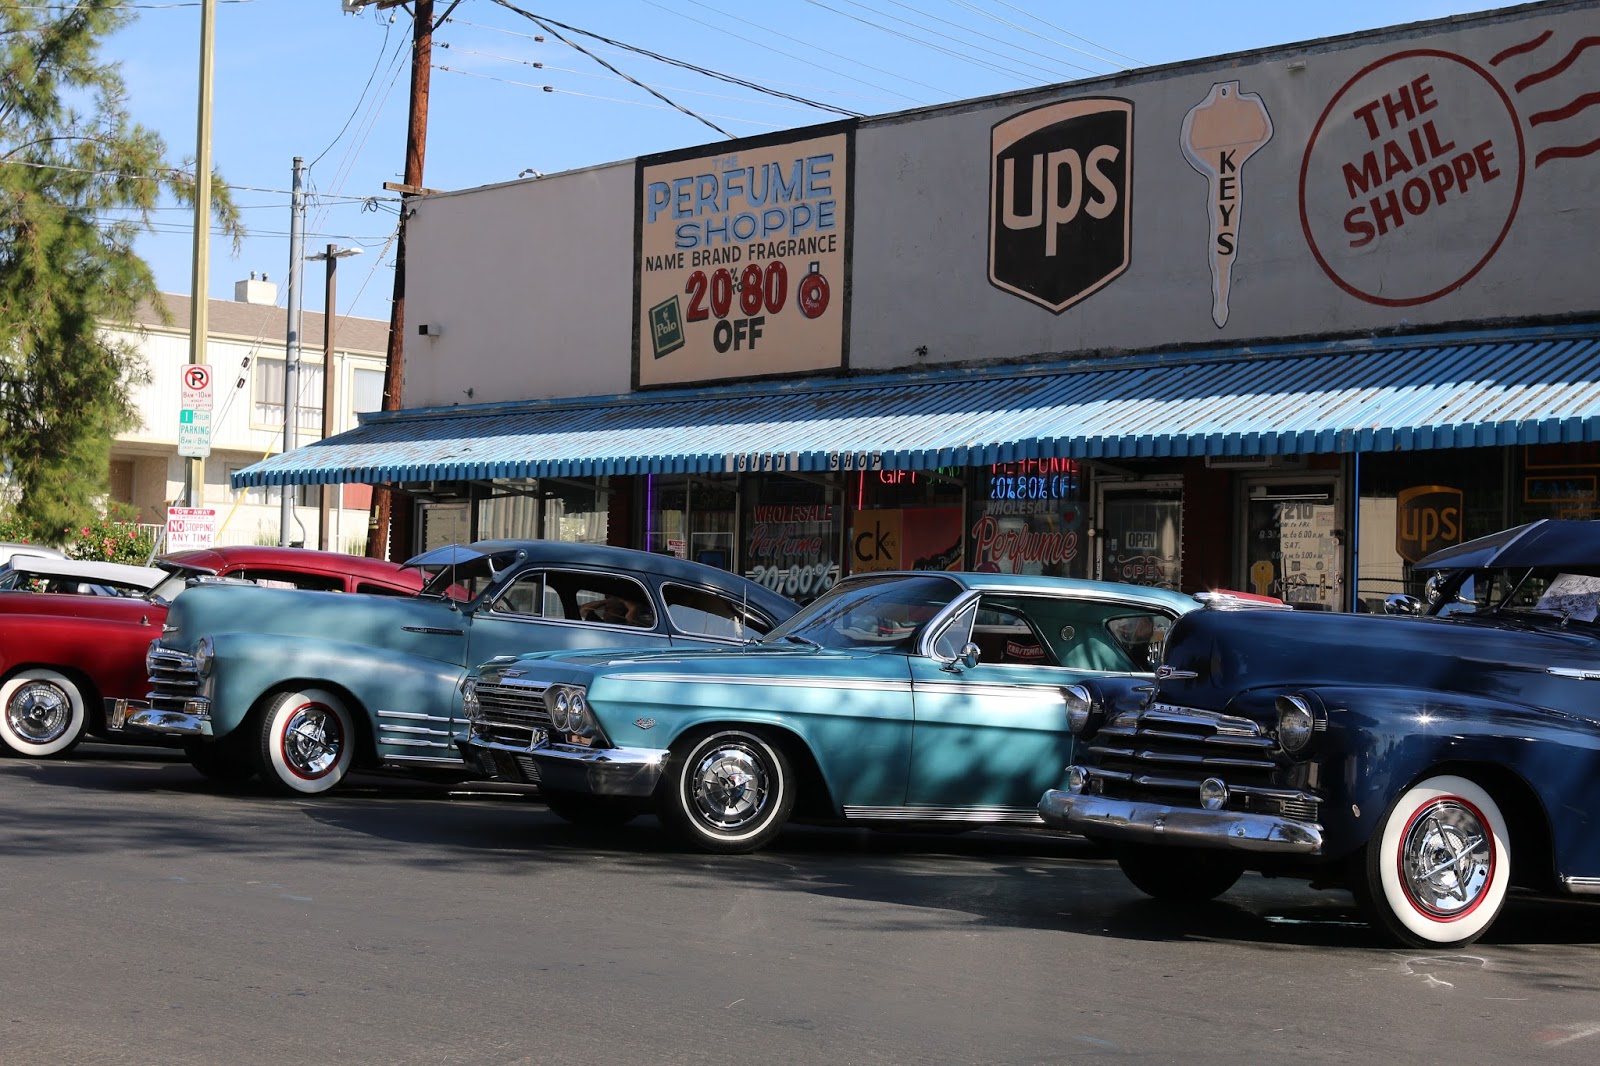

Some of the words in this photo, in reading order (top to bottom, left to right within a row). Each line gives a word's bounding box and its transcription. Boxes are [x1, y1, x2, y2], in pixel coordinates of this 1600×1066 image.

[1353, 73, 1439, 141] THE
[712, 156, 738, 171] THE
[1341, 119, 1456, 200] MAIL
[647, 153, 834, 224] PERFUME
[1343, 139, 1501, 248] SHOPPE
[1217, 149, 1236, 255] KEYS
[675, 199, 836, 249] SHOPPE
[645, 252, 684, 272] NAME
[692, 246, 741, 267] BRAND
[748, 234, 837, 262] FRAGRANCE
[656, 319, 677, 337] Polo
[713, 315, 765, 353] OFF
[180, 425, 210, 435] PARKING
[830, 454, 881, 468] SHOP
[754, 504, 832, 523] WHOLESALE
[1272, 502, 1313, 520] 7210
[170, 520, 184, 532] NO
[185, 522, 214, 532] STOPPING
[172, 533, 189, 542] ANY
[193, 533, 212, 543] TIME
[749, 523, 823, 559] Perfume
[971, 510, 1079, 575] Perfume
[1129, 532, 1154, 548] OPEN
[1122, 564, 1165, 579] OPEN
[1273, 572, 1307, 594] KEYS
